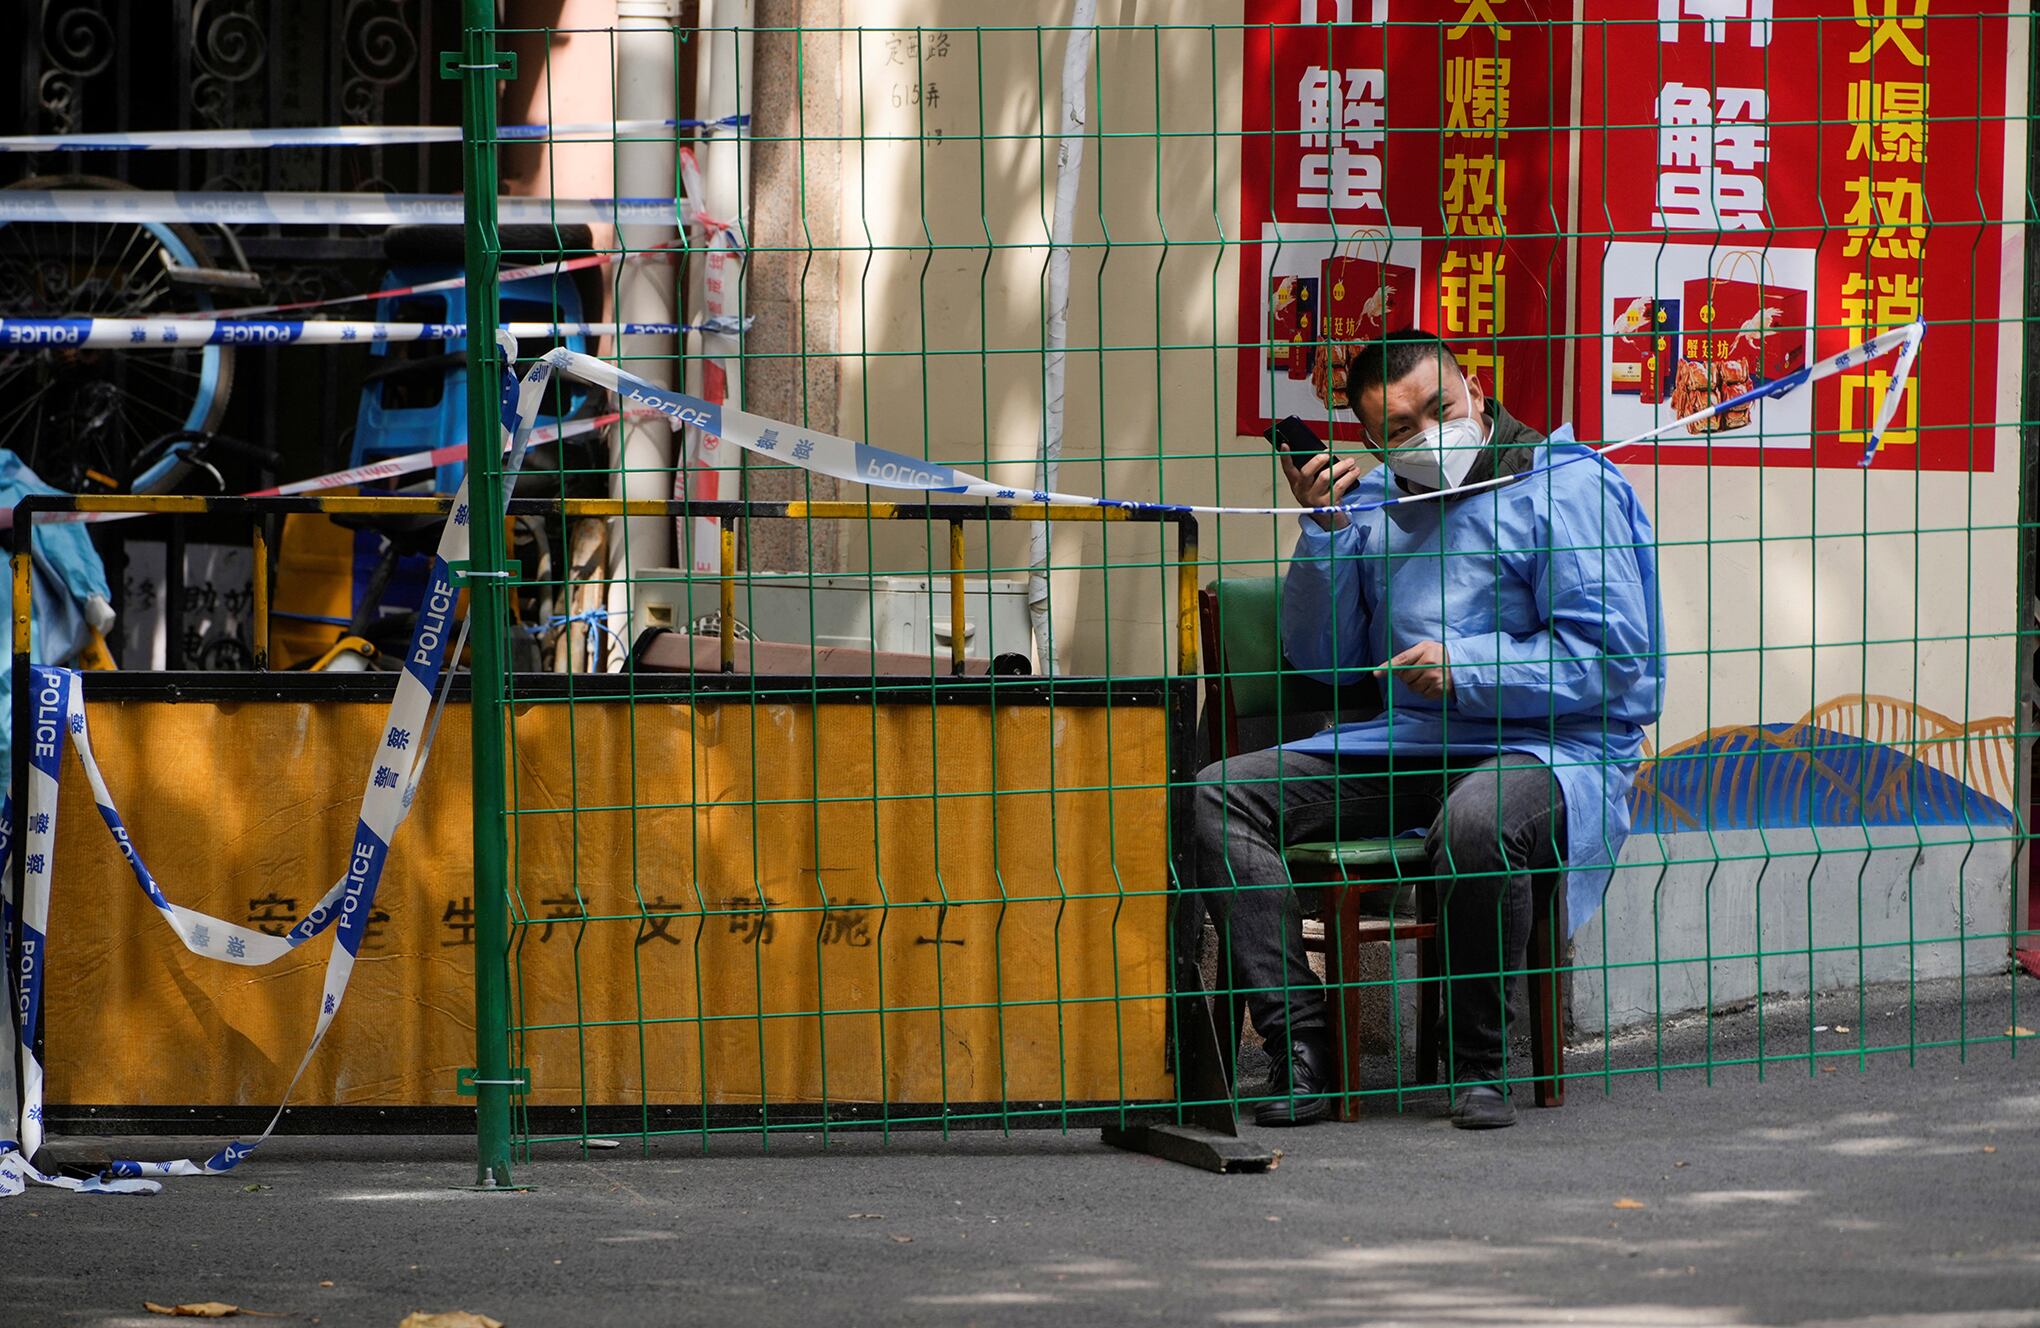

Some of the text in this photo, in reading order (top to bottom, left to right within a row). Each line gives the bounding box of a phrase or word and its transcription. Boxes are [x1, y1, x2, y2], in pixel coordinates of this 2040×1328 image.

[1297, 0, 1388, 209] 蟹
[9, 325, 79, 343] POLICE
[222, 325, 290, 343] POLICE
[414, 579, 453, 667] POLICE
[36, 673, 60, 757] POLICE
[374, 726, 411, 789] 警察
[27, 812, 49, 875] 警察
[339, 842, 375, 929] POLICE
[19, 940, 36, 1027] POLICE
